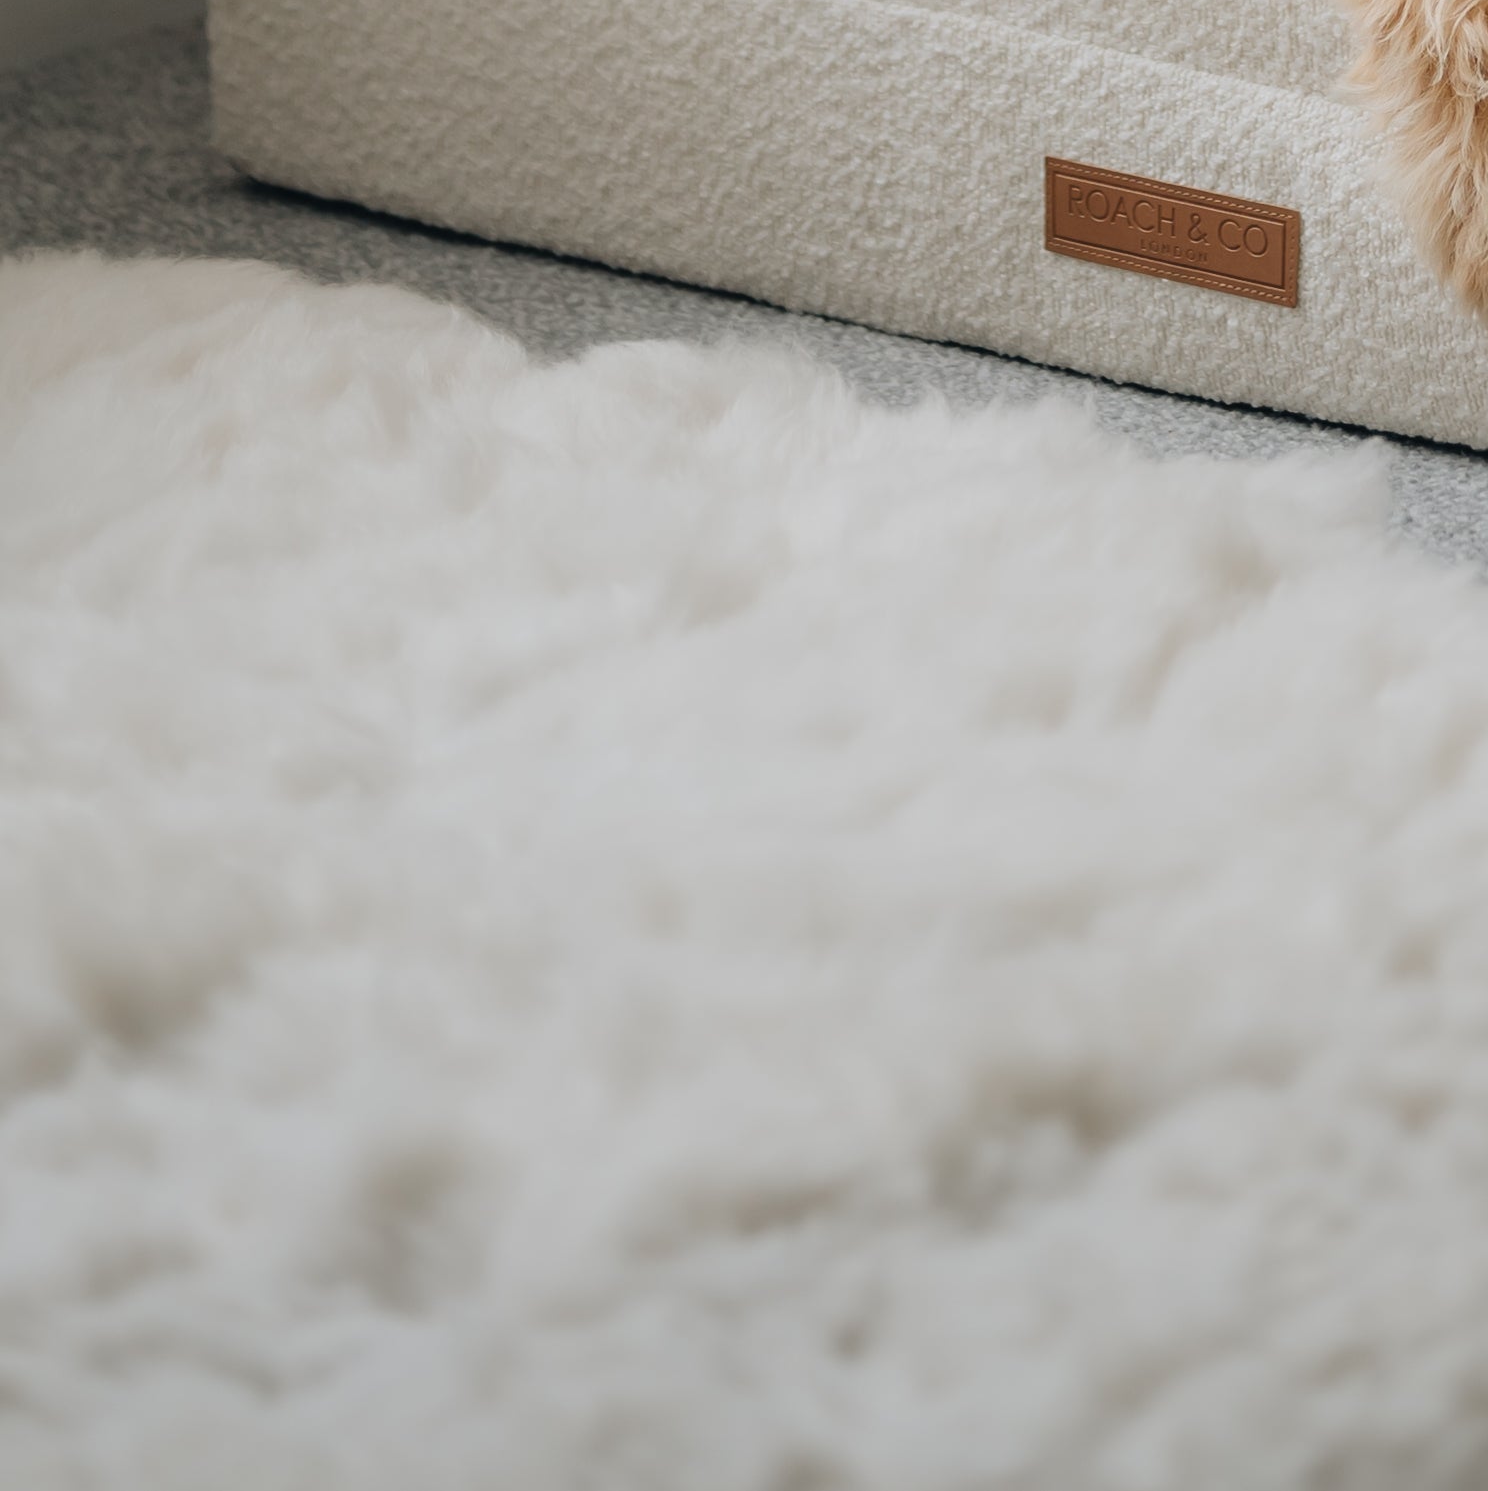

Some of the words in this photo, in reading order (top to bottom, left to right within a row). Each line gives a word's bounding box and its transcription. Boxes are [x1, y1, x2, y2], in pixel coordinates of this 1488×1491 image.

[1067, 184, 1177, 238] ROACH
[1187, 212, 1211, 247] &
[1217, 218, 1270, 258] CO
[1139, 238, 1209, 263] LONDON
